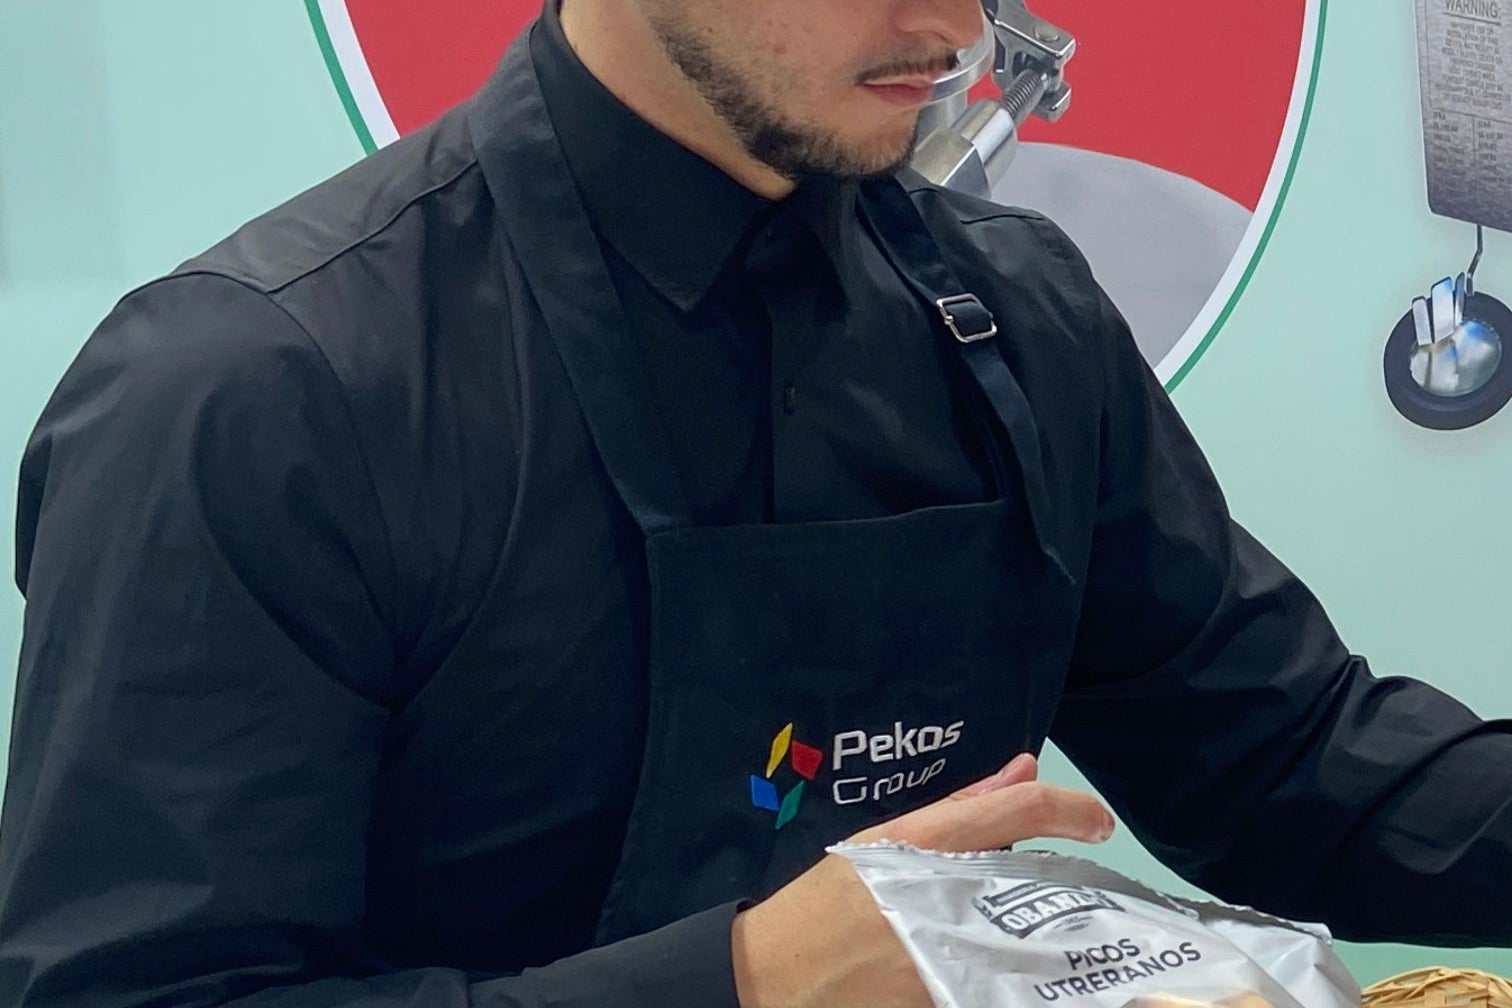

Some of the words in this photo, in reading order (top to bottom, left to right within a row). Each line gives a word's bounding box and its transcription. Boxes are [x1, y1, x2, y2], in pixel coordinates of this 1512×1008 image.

[832, 720, 965, 771] Pekos
[832, 758, 946, 805] Group
[1033, 942, 1202, 1001] UTRERANOS
[1064, 938, 1141, 971] PICOS
